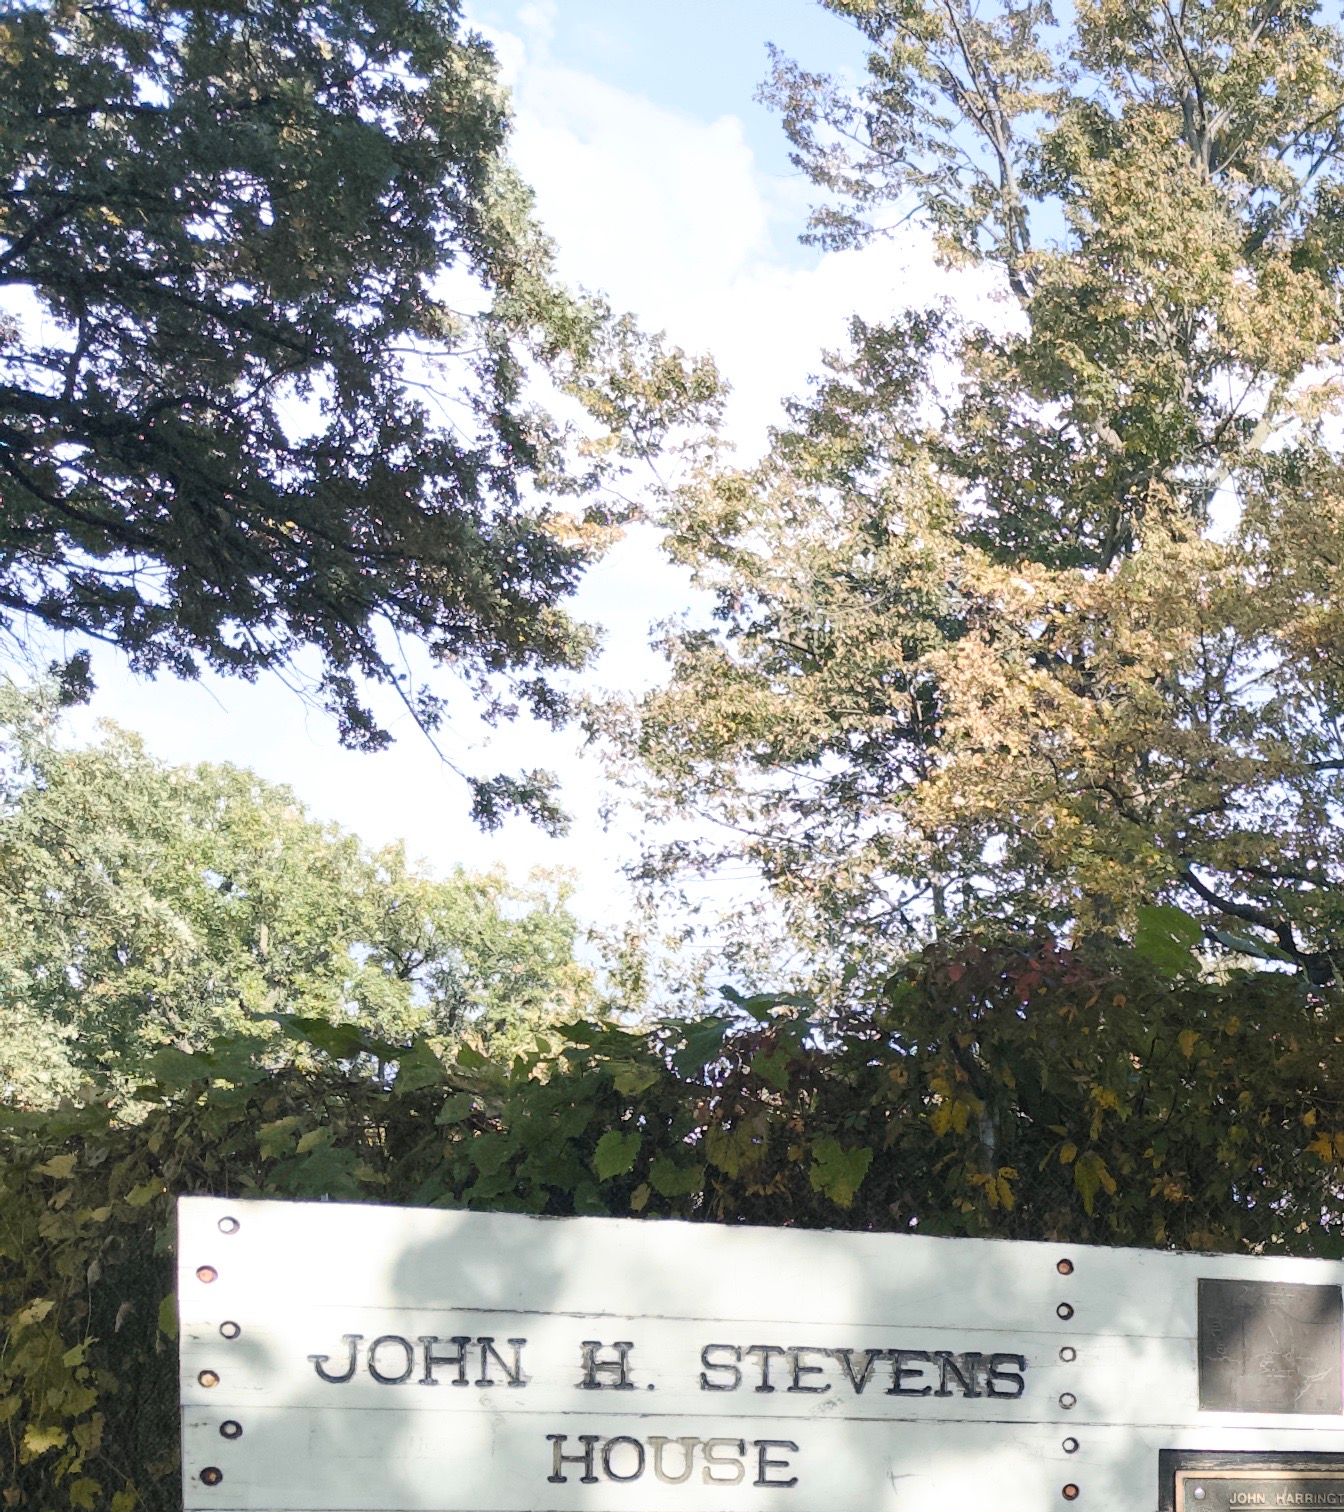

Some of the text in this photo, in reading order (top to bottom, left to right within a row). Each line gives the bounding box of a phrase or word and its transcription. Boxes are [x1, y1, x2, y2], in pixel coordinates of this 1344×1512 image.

[307, 1334, 1027, 1399] JOHN H. STEVENS
[545, 1434, 799, 1488] HOUSE
[1230, 1493, 1265, 1504] JOHN
